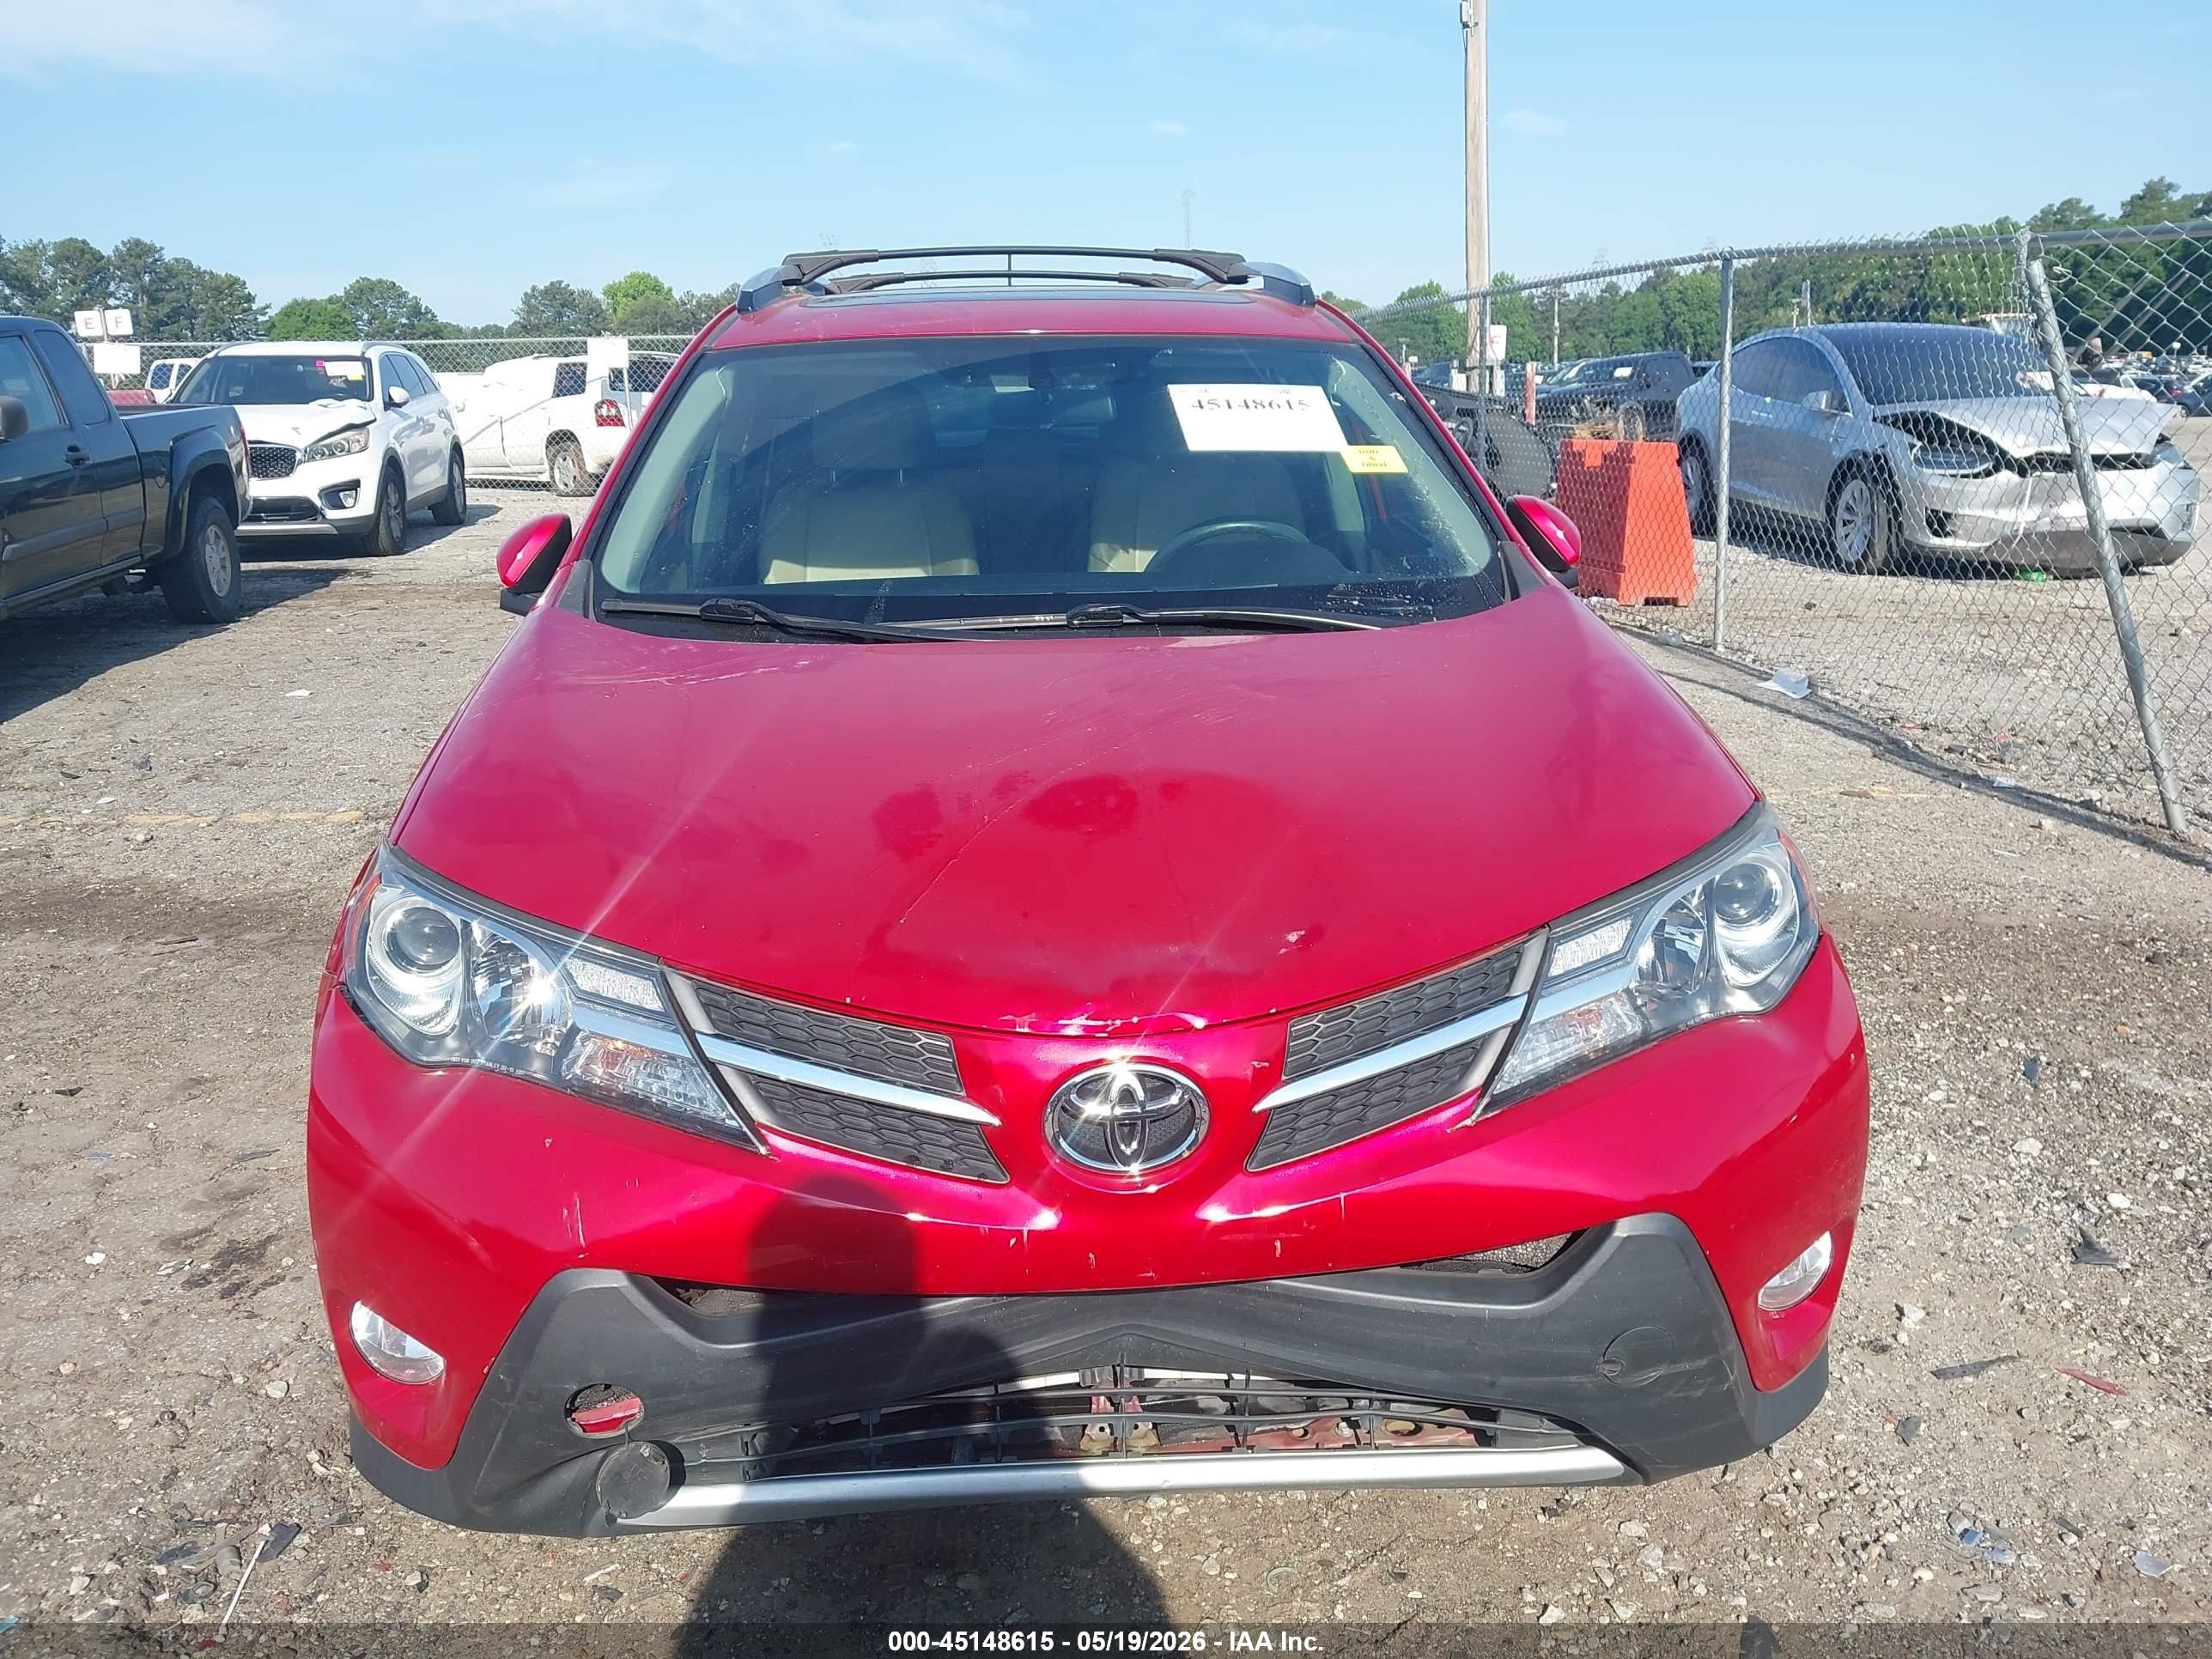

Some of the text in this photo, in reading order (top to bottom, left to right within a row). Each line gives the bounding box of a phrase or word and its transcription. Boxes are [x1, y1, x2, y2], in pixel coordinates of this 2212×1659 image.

[83, 317, 95, 330] E
[114, 316, 123, 329] F
[1191, 398, 1310, 410] 45148615
